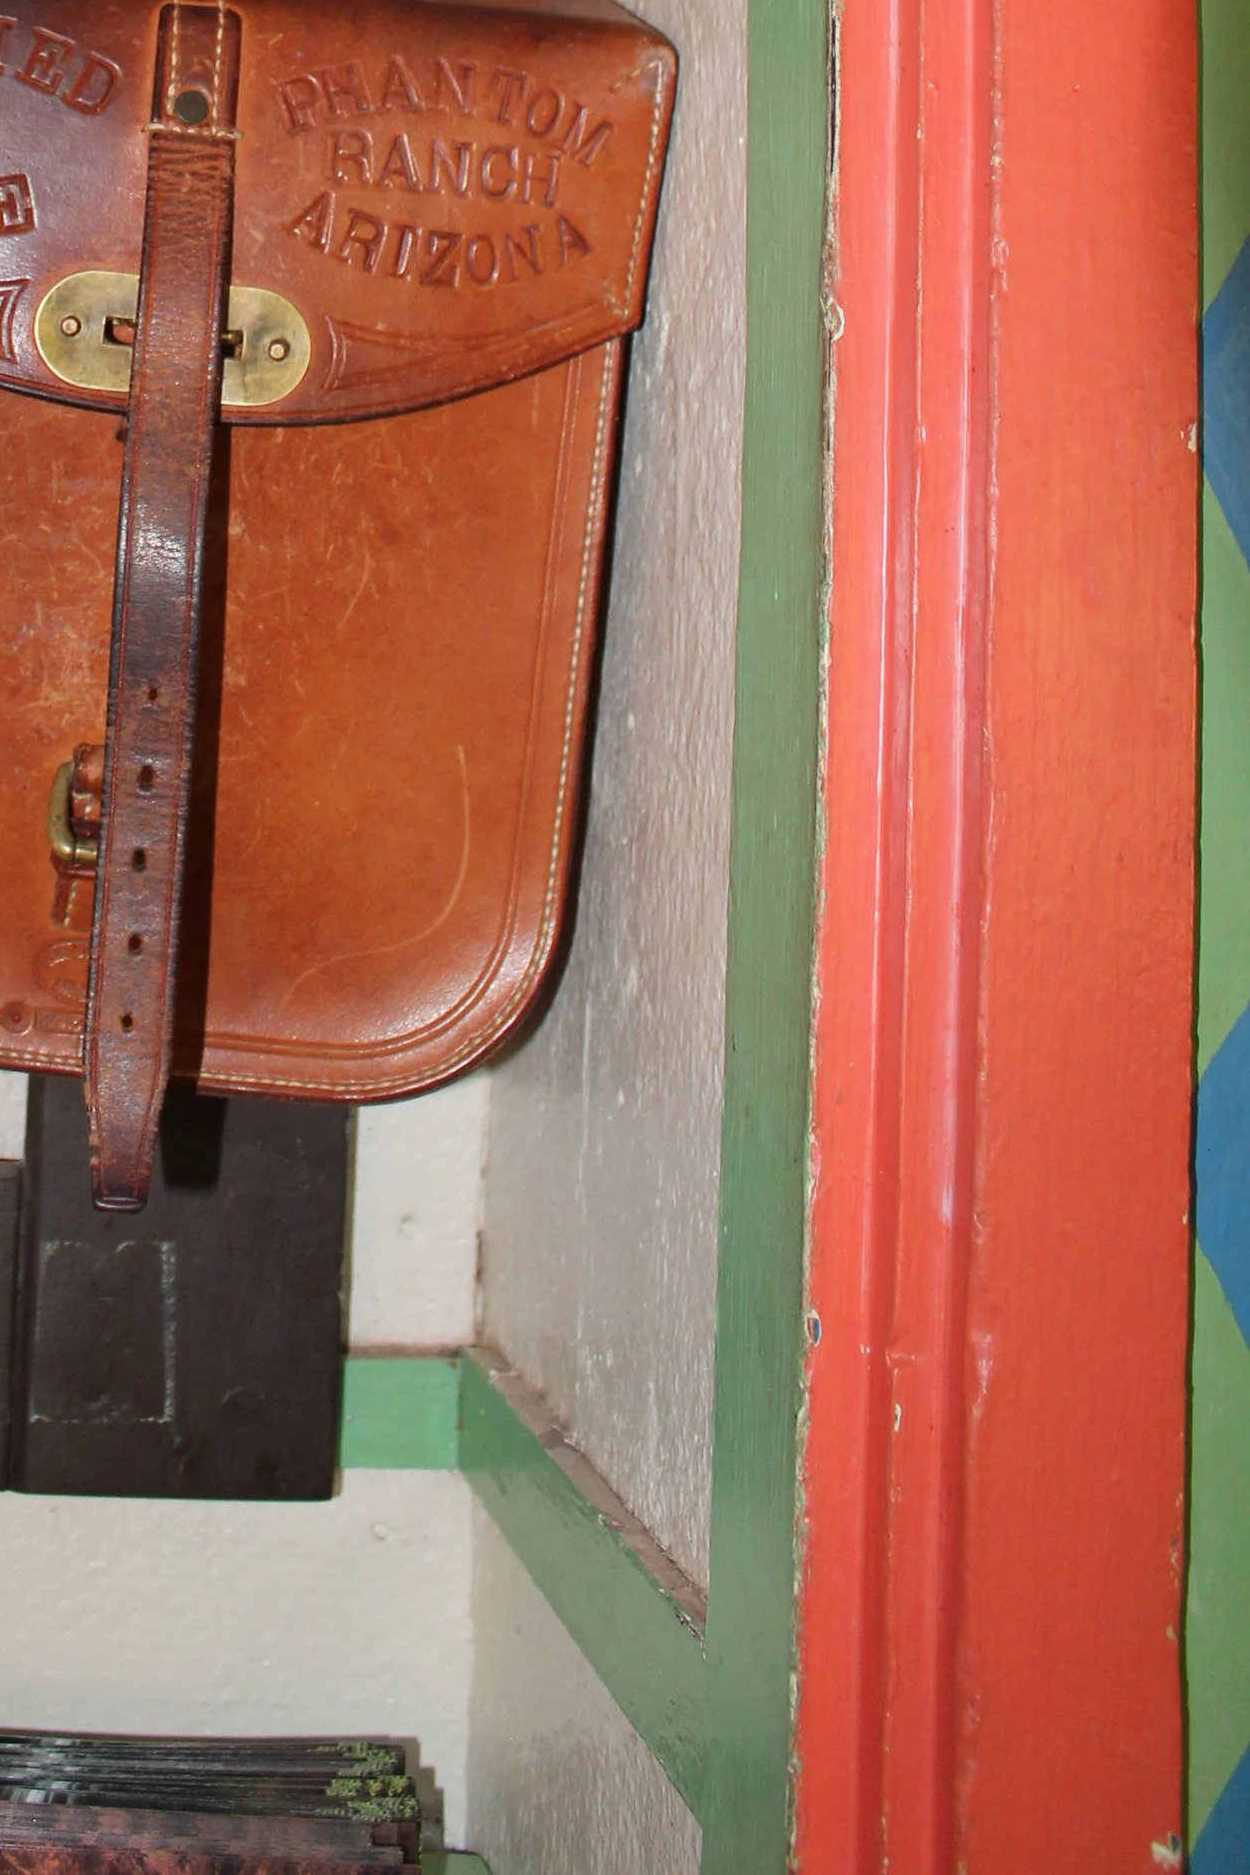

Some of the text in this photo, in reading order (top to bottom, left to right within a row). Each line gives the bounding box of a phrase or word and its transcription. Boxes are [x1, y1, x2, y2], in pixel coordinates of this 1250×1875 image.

[269, 54, 617, 171] PHANTOM
[326, 127, 565, 209] RANCH
[281, 190, 597, 291] ARIZONA
